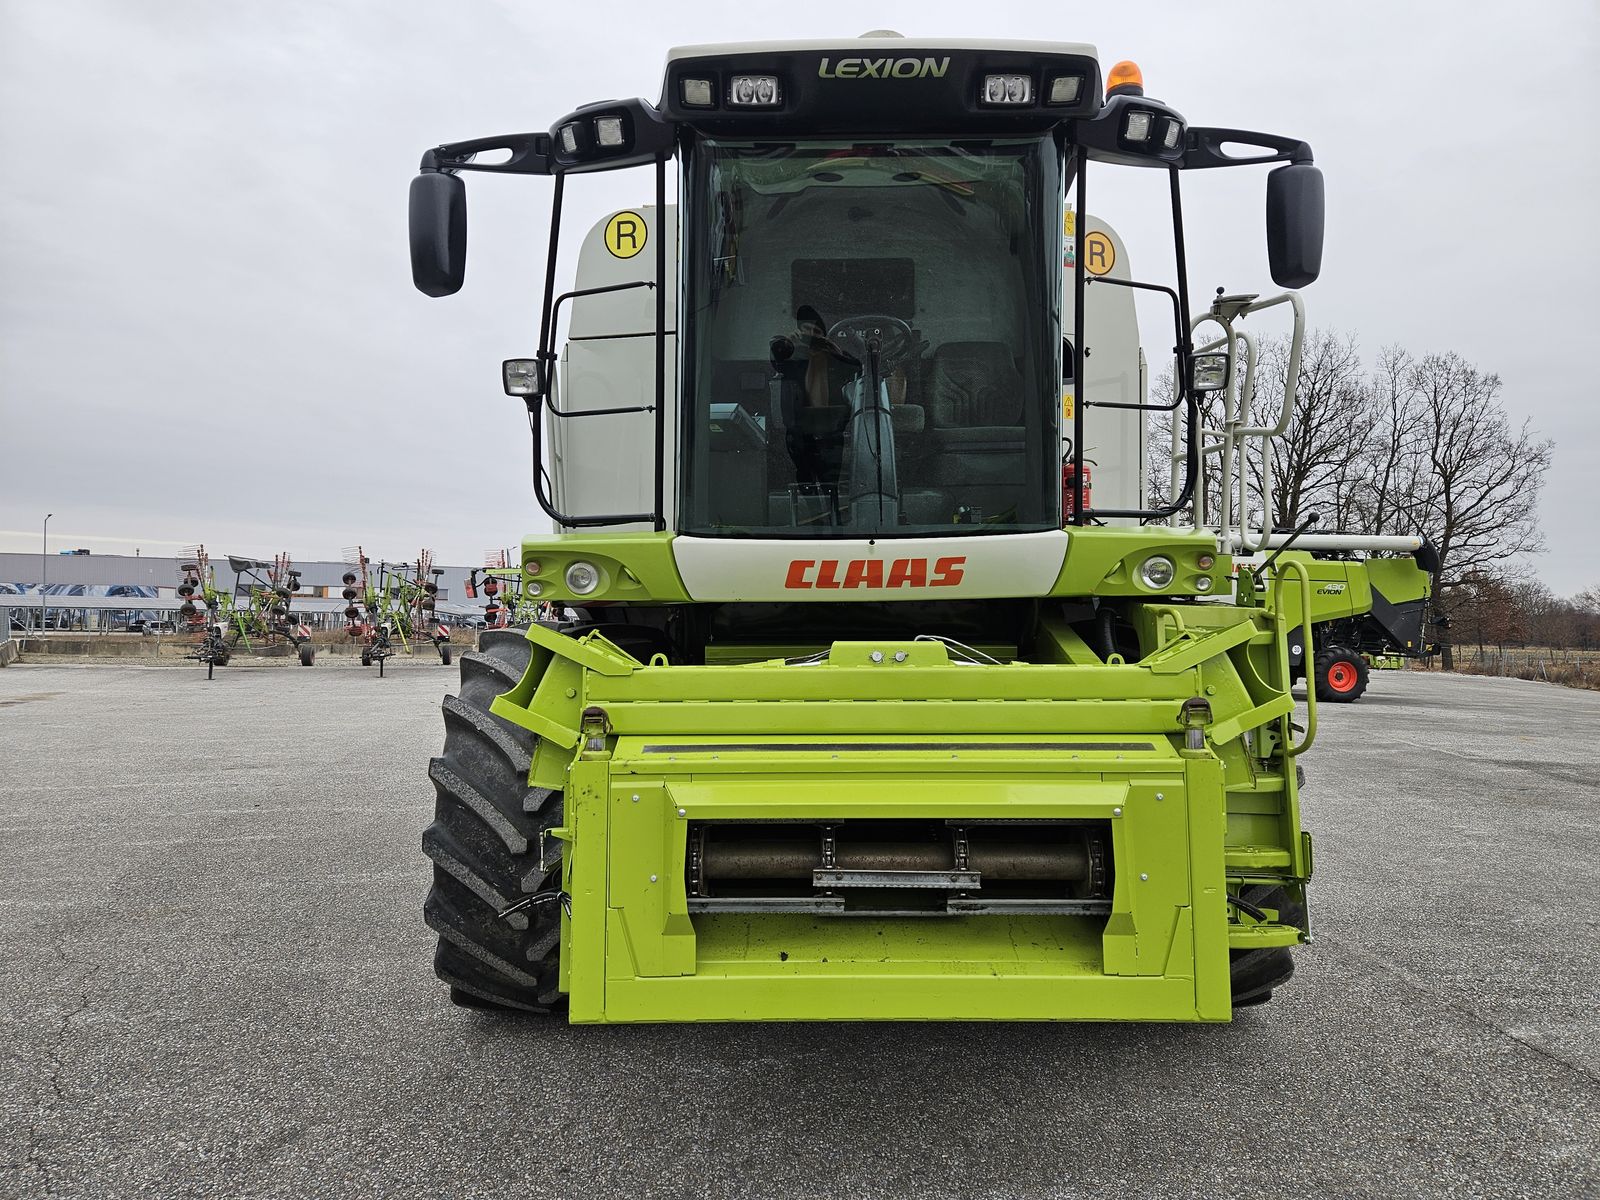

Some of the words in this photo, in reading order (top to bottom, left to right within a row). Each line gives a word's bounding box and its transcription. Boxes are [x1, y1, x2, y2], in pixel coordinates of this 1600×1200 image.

[818, 57, 950, 79] LEXION
[616, 220, 637, 250] R
[1089, 239, 1106, 267] R
[785, 557, 967, 589] CLAAS
